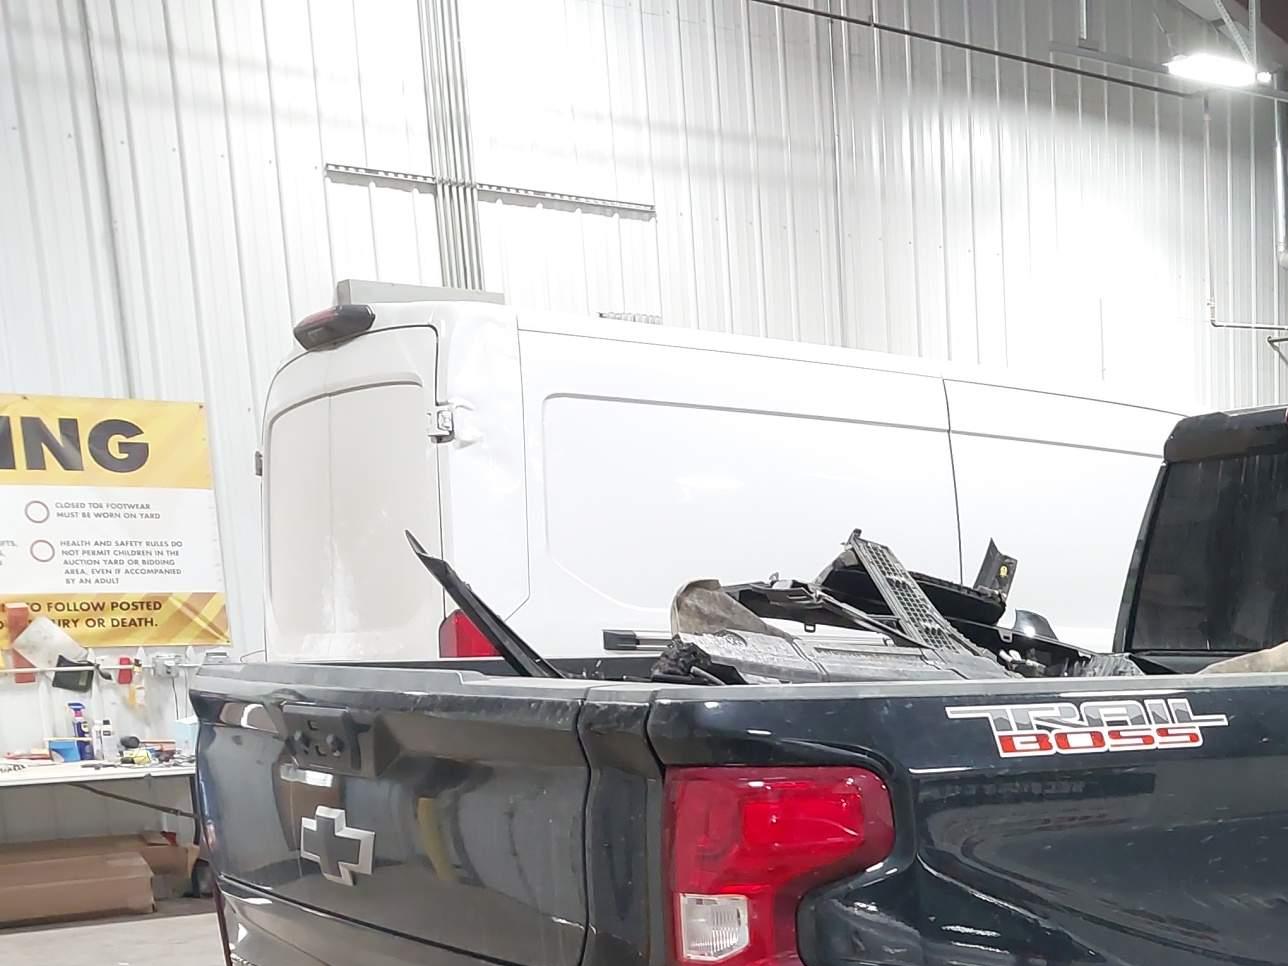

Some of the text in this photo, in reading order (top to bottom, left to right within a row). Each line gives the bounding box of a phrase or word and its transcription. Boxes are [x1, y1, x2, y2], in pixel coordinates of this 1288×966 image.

[166, 549, 180, 557] THE
[47, 601, 106, 613] FOLLOW
[111, 600, 163, 611] POSTED
[85, 618, 106, 628] OR
[111, 617, 158, 628] DEATH.
[945, 698, 1229, 731] TRAIL
[996, 725, 1202, 759] BOSS
